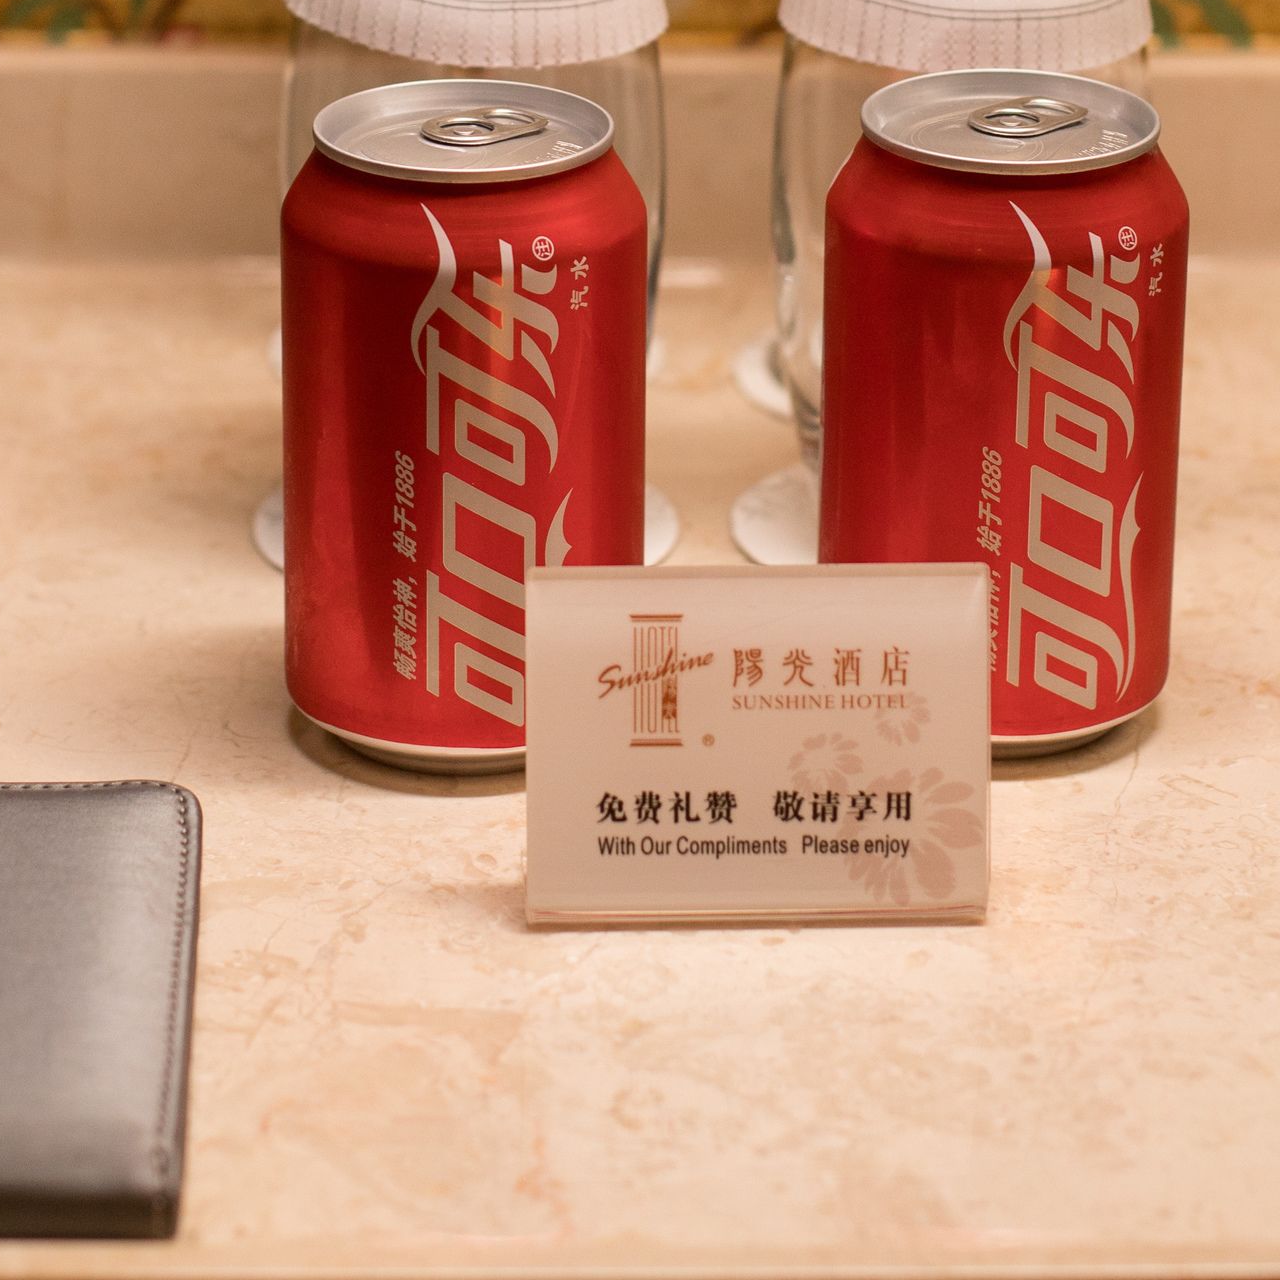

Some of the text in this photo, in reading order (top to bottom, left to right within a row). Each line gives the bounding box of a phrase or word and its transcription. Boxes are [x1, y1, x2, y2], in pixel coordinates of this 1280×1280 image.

[570, 256, 589, 310] 汽水
[1148, 243, 1165, 297] 汽水
[411, 203, 559, 727] 可口可乐
[1003, 200, 1141, 710] 可口可乐
[598, 647, 715, 700] Sunshine
[732, 694, 910, 711] SUNSHINE HOTEL
[597, 790, 913, 824] 免费礼赞 敬请享用
[597, 834, 910, 860] With Our Compliments Please enjoy
